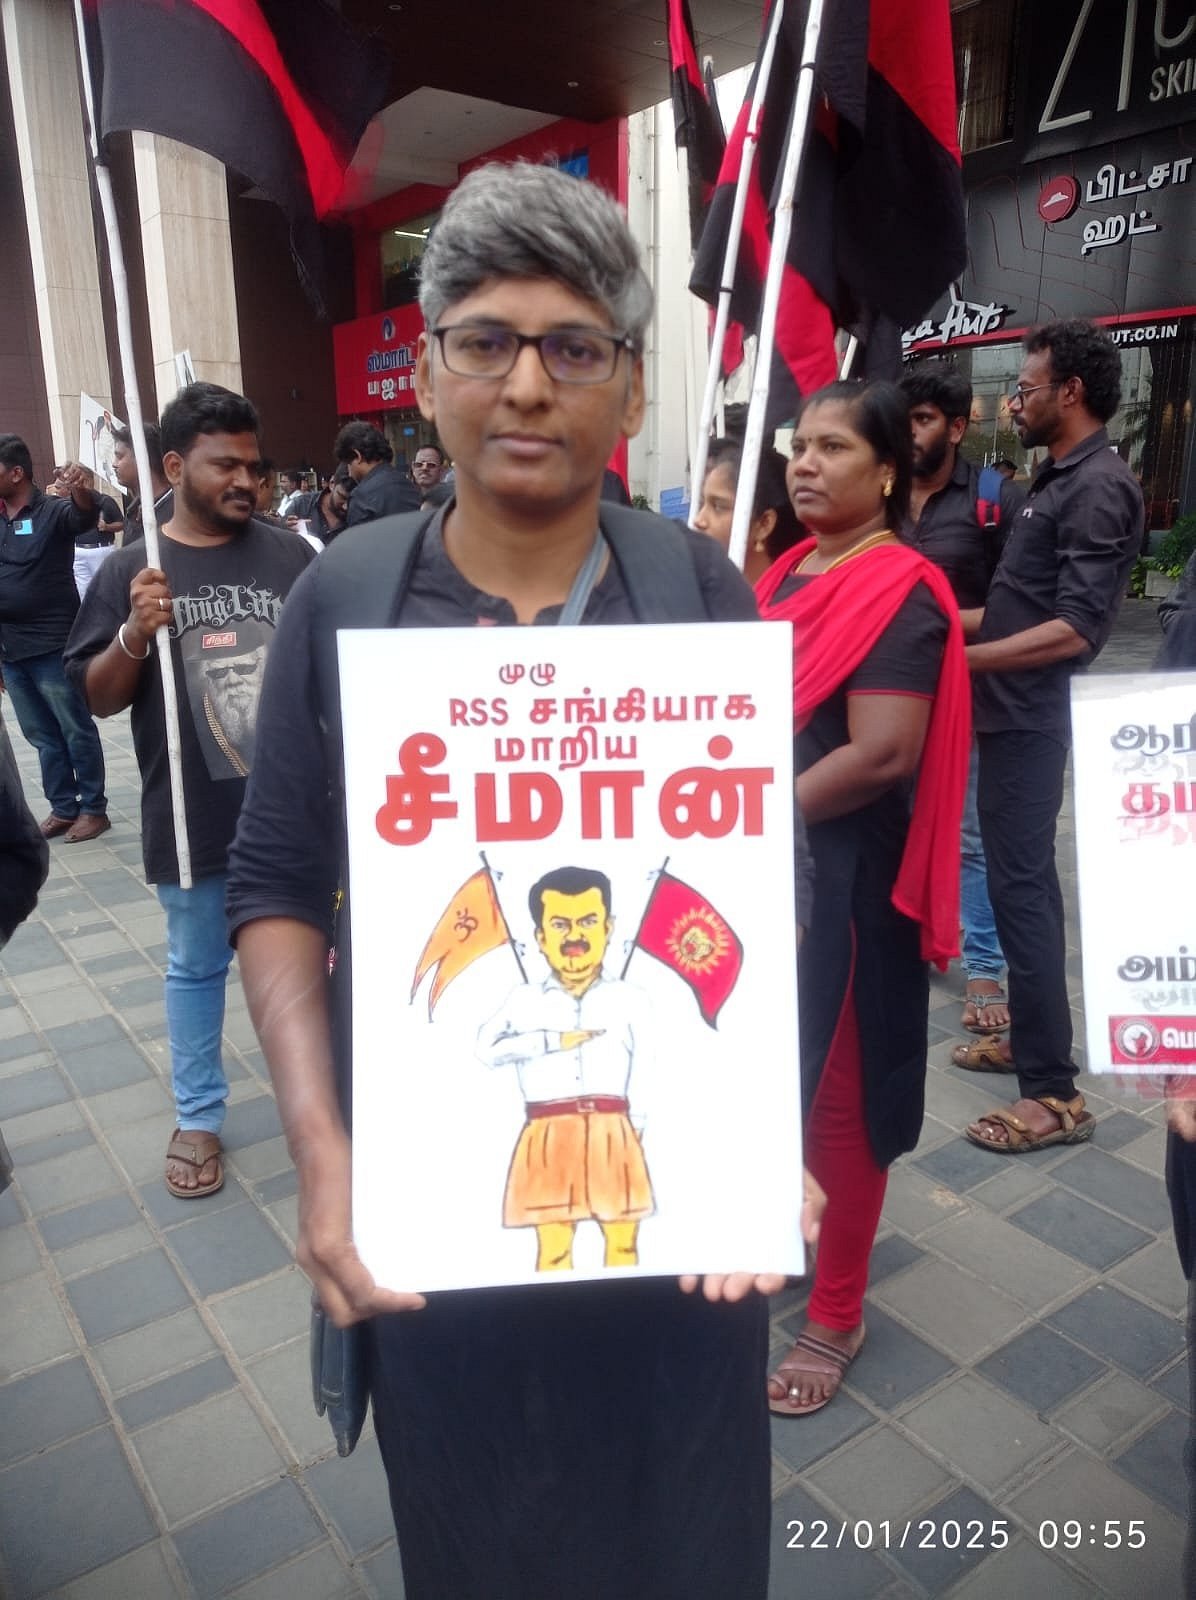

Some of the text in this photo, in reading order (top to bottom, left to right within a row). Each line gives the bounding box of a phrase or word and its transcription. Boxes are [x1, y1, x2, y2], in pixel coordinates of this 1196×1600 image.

[1150, 57, 1196, 101] SKI
[1086, 157, 1193, 203] பிட்சா
[1081, 210, 1157, 255] ஹட்
[1111, 324, 1178, 344] UT.CO.IN
[499, 662, 556, 686] முழு
[449, 687, 756, 727] RSS சங்கியாக
[494, 726, 637, 771] மாறிய
[375, 732, 775, 846] சீமான்
